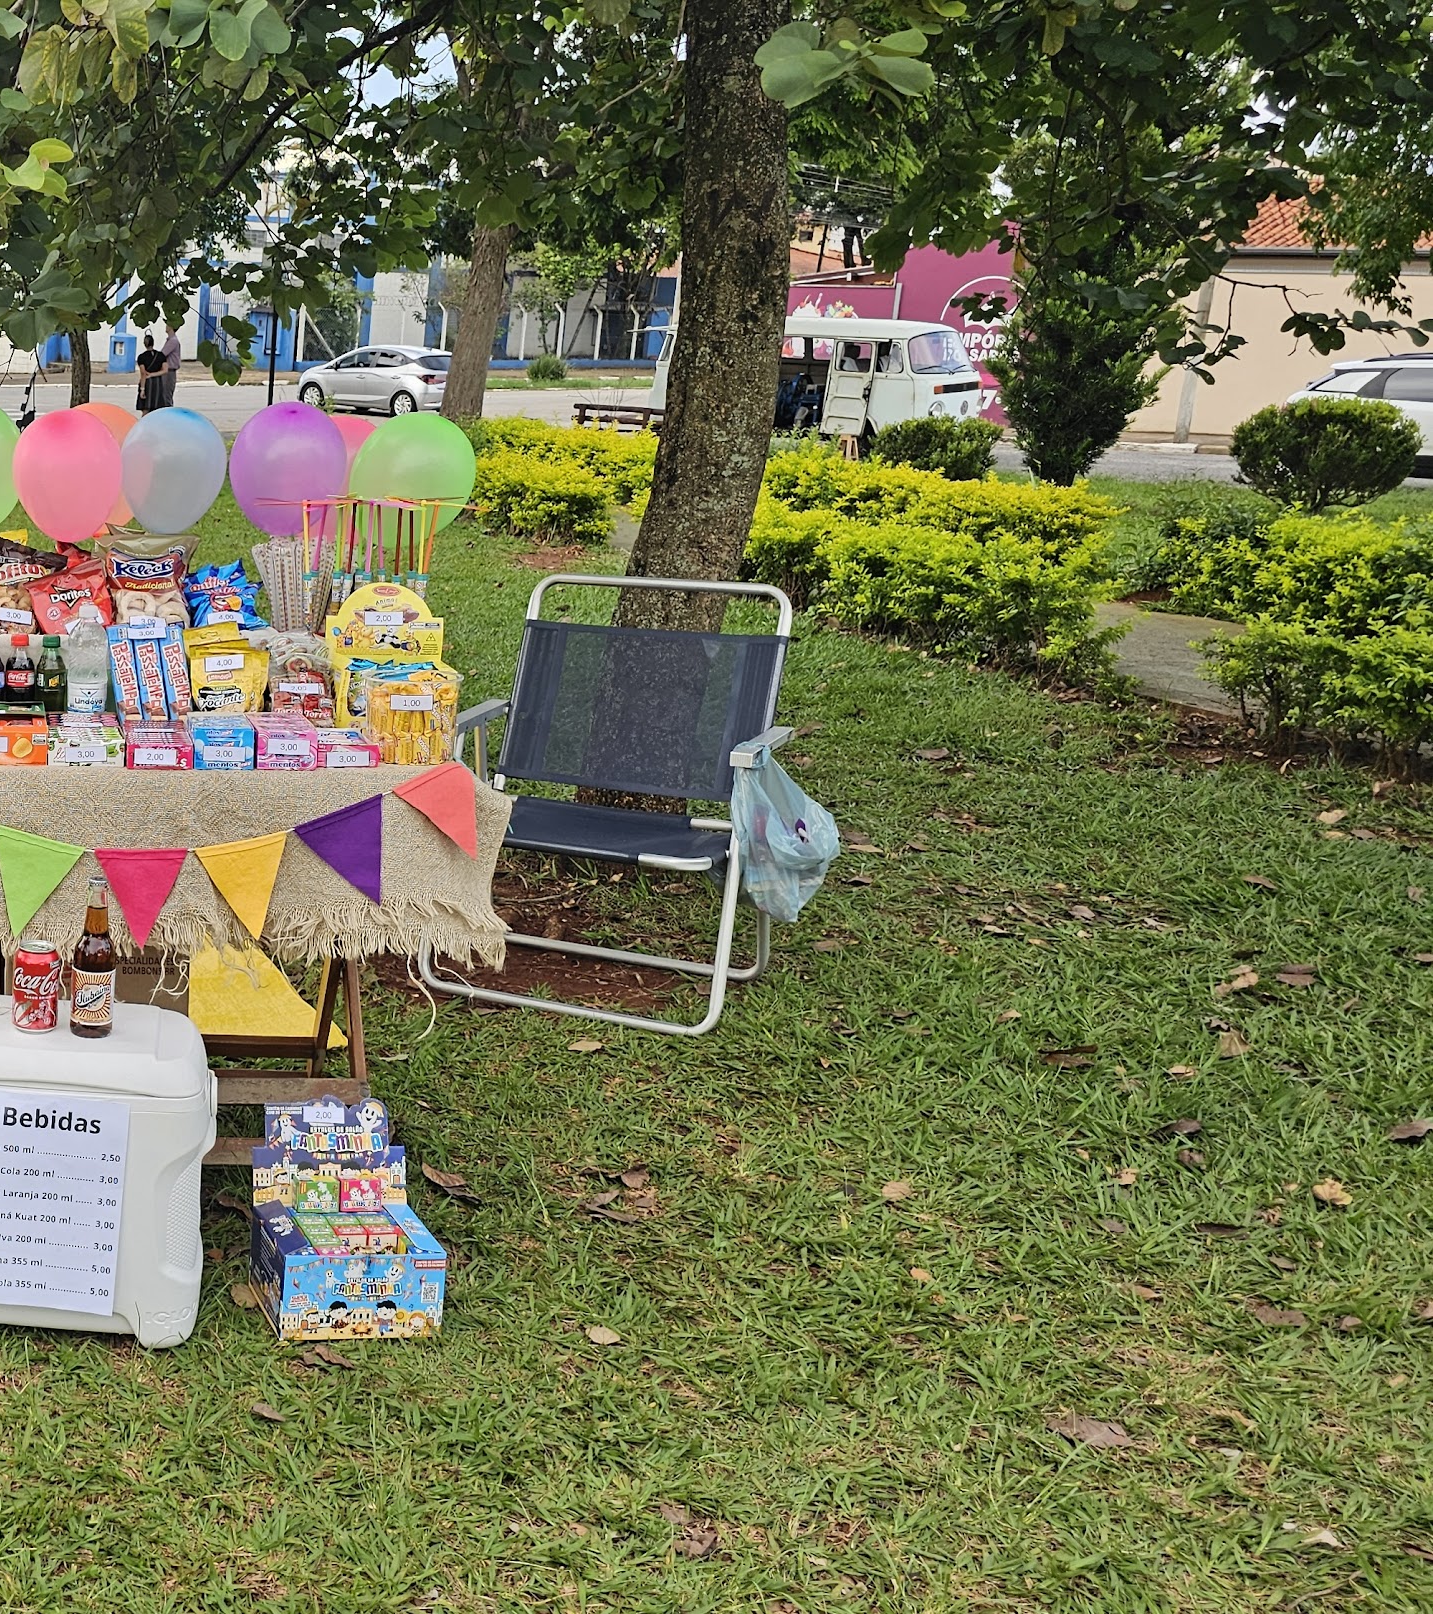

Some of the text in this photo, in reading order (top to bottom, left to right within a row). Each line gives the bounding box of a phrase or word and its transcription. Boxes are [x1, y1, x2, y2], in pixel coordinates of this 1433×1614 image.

[125, 580, 174, 590] Tradicional
[50, 588, 91, 603] Doritos
[2, 1106, 101, 1134] Bebidas
[316, 1111, 332, 1119] 2,00
[291, 1132, 383, 1152] FANTASMINHA
[3, 1144, 20, 1153] 500
[101, 1154, 120, 1162] 2,50
[0, 1167, 20, 1176] Cola
[24, 1168, 40, 1176] 200
[100, 1176, 118, 1184] 3,00
[3, 1190, 39, 1200] Laranja
[42, 1192, 58, 1200] 200
[61, 1194, 73, 1202] ml
[97, 1198, 116, 1207] 3,00
[15, 1212, 37, 1222] Kuat
[40, 1214, 56, 1223] 200
[96, 1220, 114, 1230] 3,00
[16, 1235, 32, 1243] 200
[94, 1242, 112, 1252] 3,00
[12, 1256, 28, 1266] 355
[92, 1265, 110, 1274] 5,00
[15, 1280, 32, 1288] 355
[34, 1282, 46, 1290] ml
[90, 1288, 108, 1297] 5,00
[332, 1282, 402, 1296] FANTASMINHA
